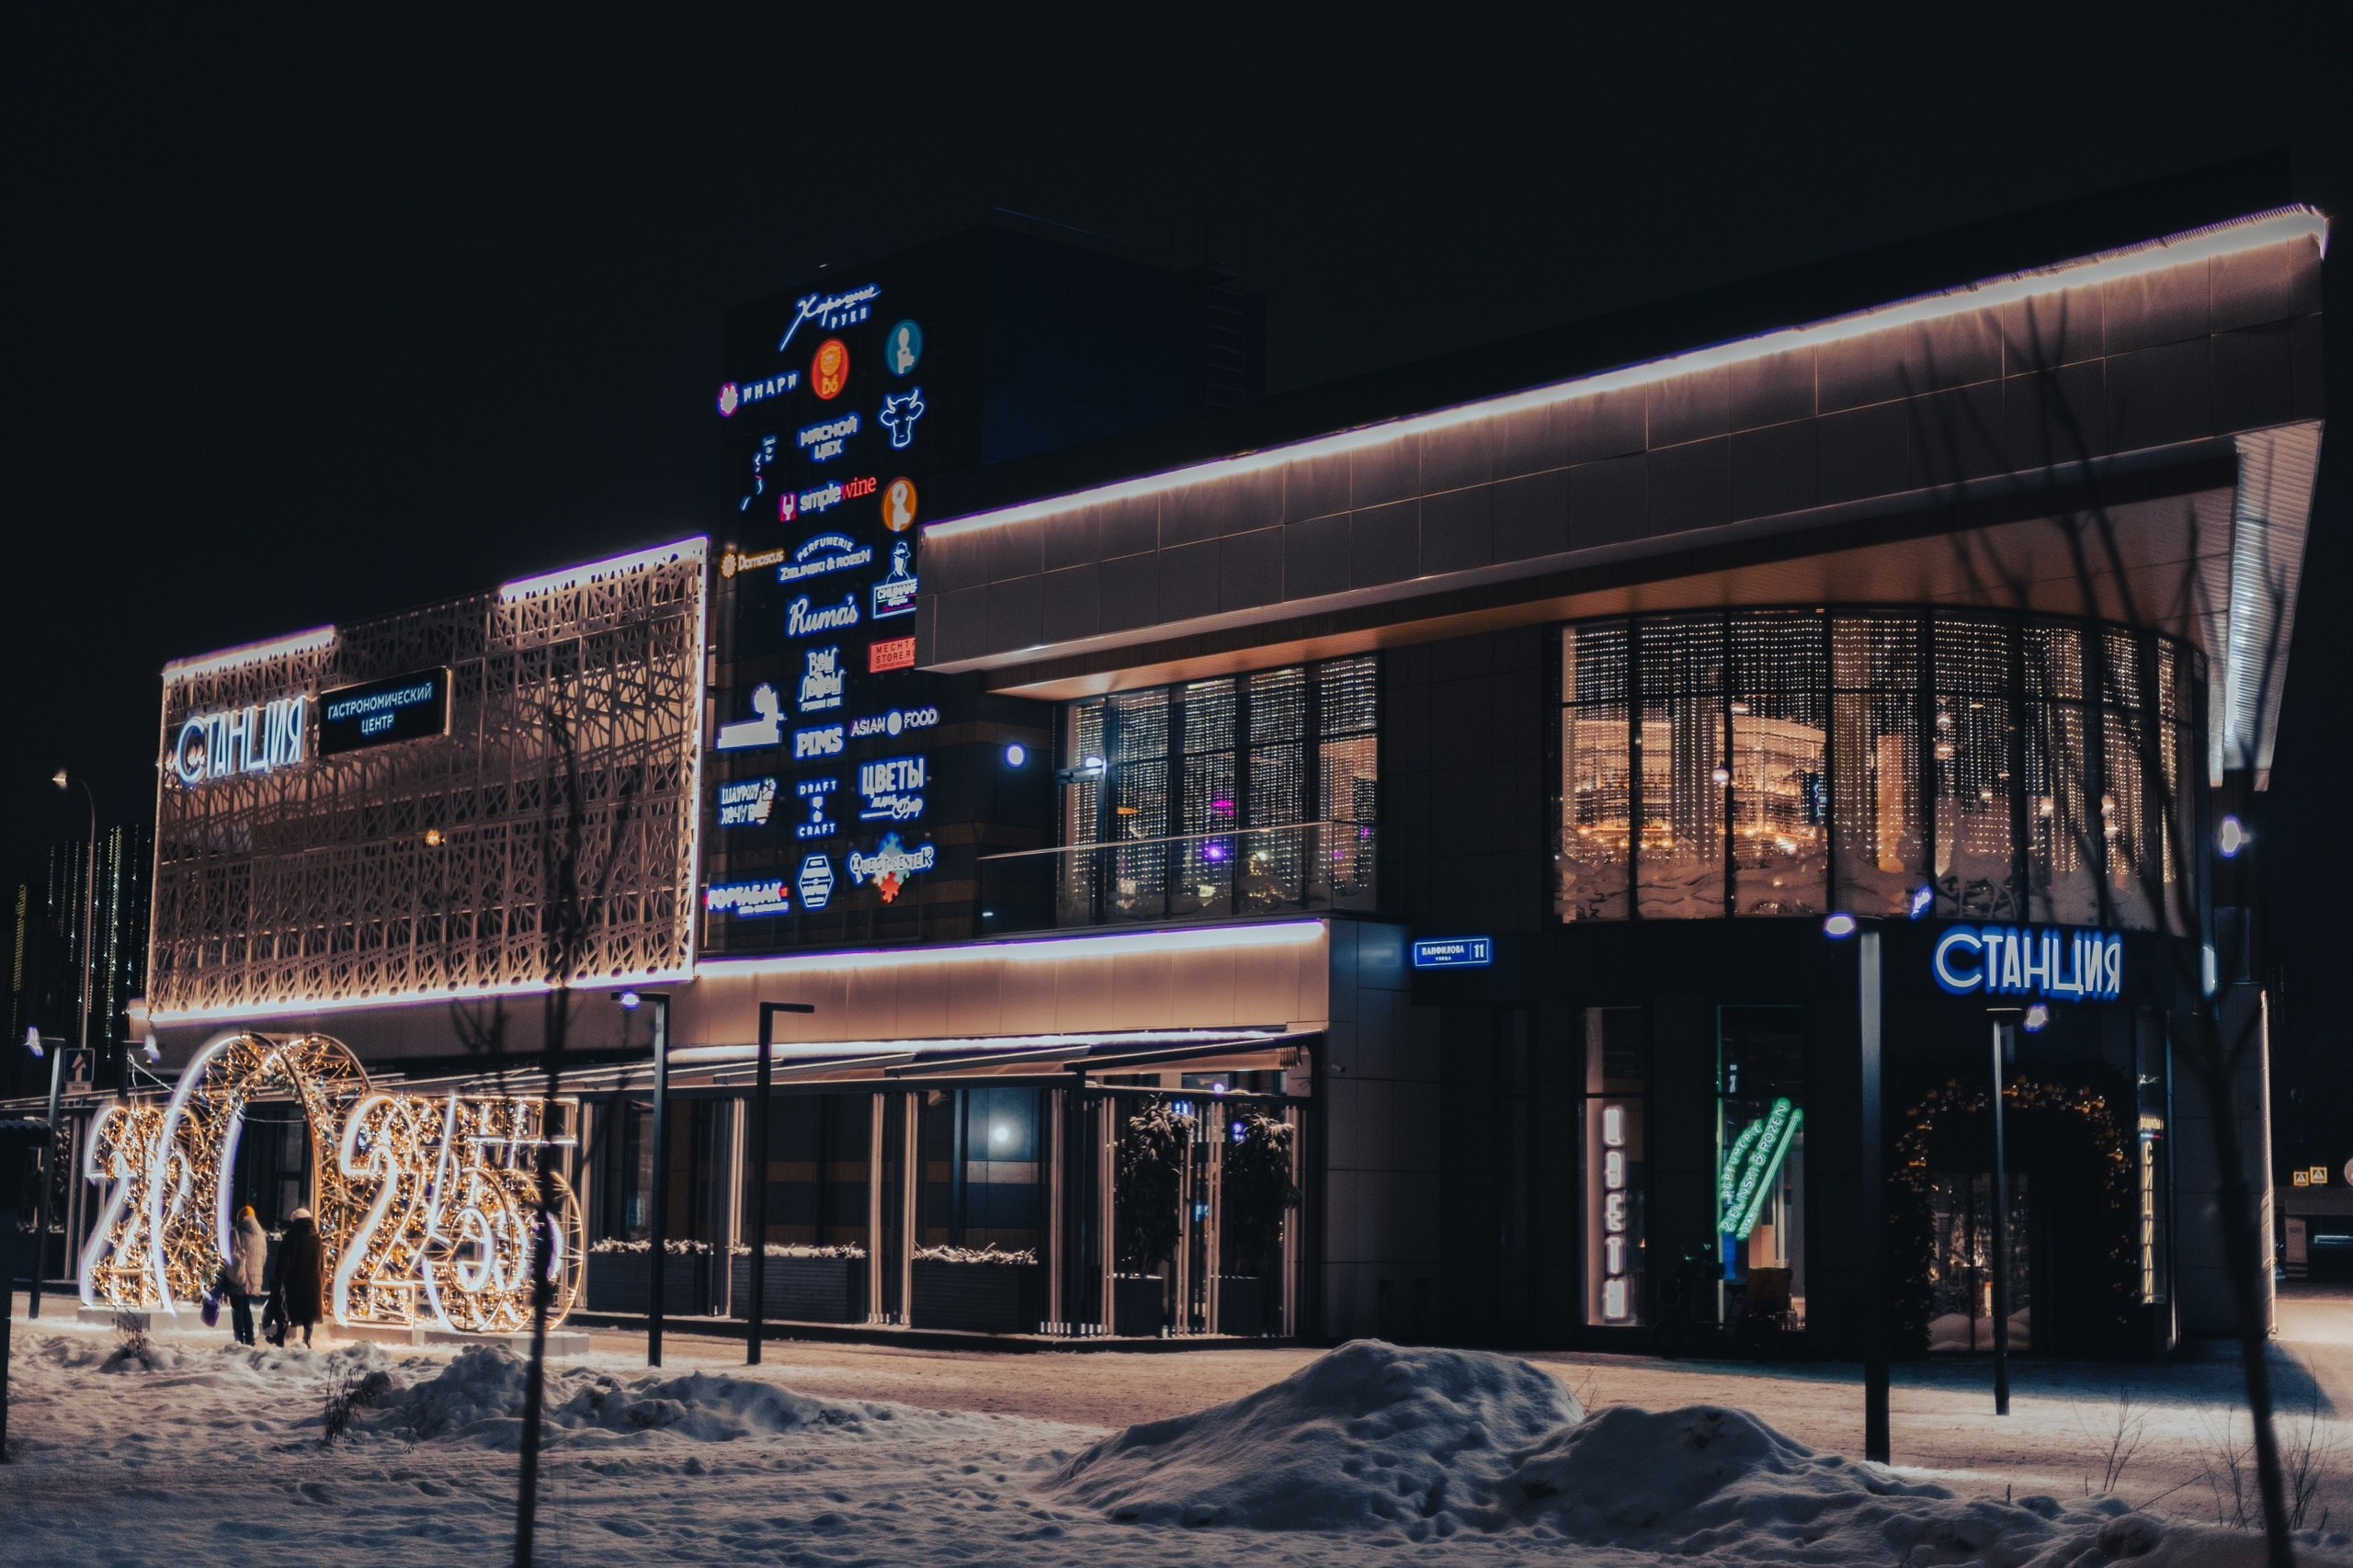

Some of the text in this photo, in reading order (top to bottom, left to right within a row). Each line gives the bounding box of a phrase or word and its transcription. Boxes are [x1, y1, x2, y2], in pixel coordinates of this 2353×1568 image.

[801, 416, 858, 446] МЯСНОЙ
[815, 440, 842, 460] ЦЕХ
[738, 551, 783, 571] Damascus
[797, 537, 853, 562] PERFUMERIE
[327, 682, 432, 720] ГАСТРОНОМИЧЕСКИЙ
[361, 714, 393, 734] ЦЕНТР
[852, 709, 937, 736] ASIAN FOOD
[177, 695, 306, 783] СТАНЦИЯ
[797, 728, 843, 757] PIMS
[800, 781, 837, 796] DRAFT
[862, 758, 924, 799] ЦВЕТЫ
[799, 824, 835, 836] CRAFT
[1422, 944, 1484, 958] ПАНФИЛОВА 11
[1936, 933, 2120, 994] СТАНЦИЯ
[1759, 1105, 1788, 1151] ROZEN
[2141, 1140, 2154, 1304] СИЦИЛИ
